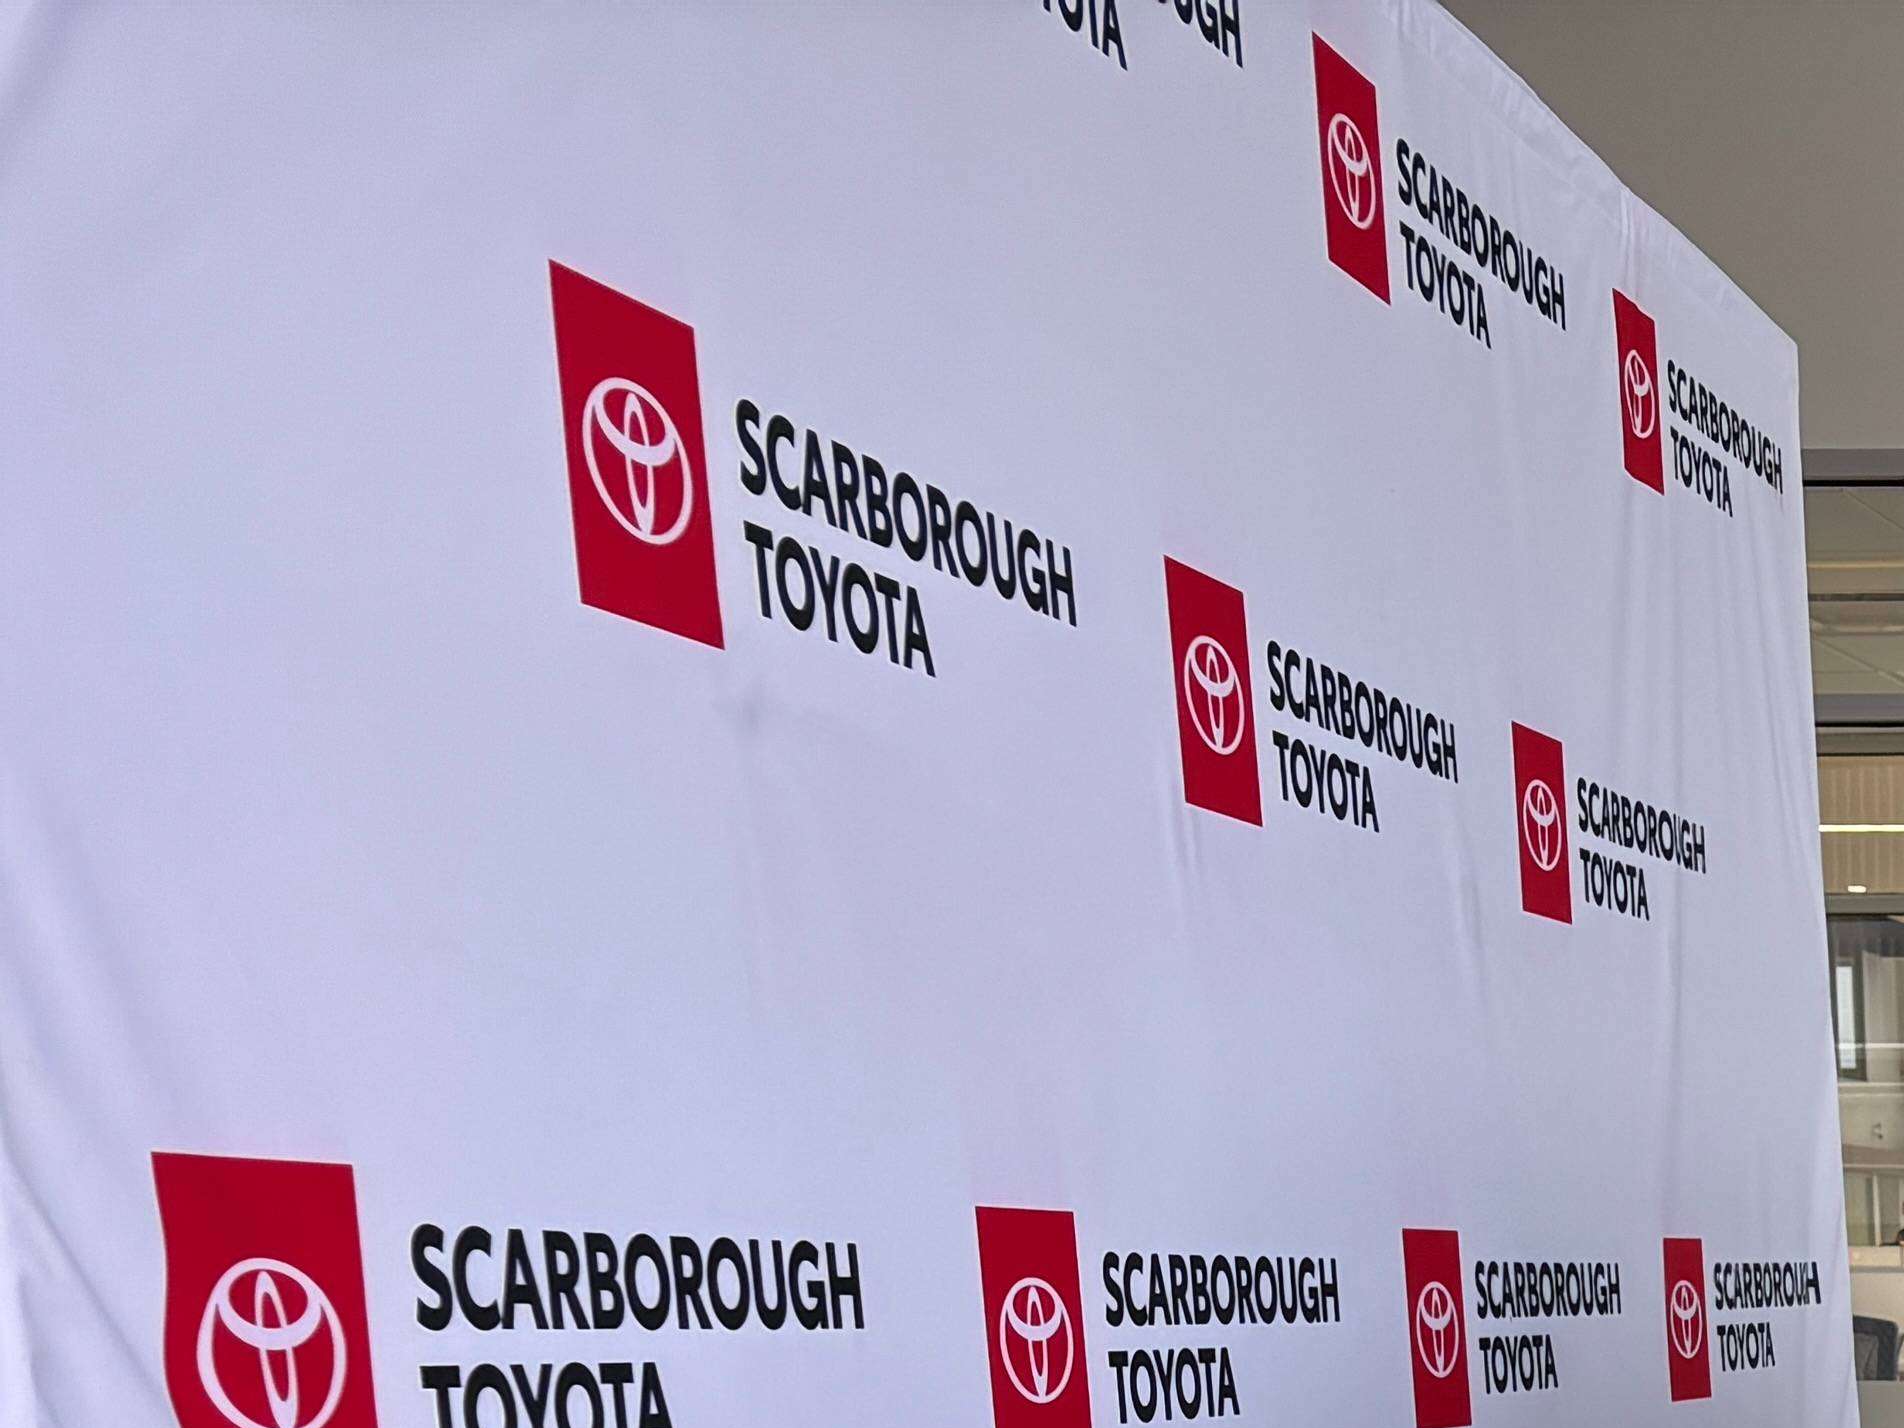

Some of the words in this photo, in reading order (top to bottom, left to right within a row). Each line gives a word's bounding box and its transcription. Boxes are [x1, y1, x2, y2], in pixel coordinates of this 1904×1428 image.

[1396, 138, 1567, 331] SCARBOROUGH
[1399, 220, 1492, 350] TOYOTA
[1667, 359, 1784, 495] SCARBOROUGH
[1669, 425, 1734, 518] TOYOTA
[736, 398, 1078, 628] SCARBOROUGH
[743, 520, 936, 678] TOYOTA
[1267, 640, 1459, 784] SCARBOROUGH
[1272, 729, 1380, 833] TOYOTA
[1576, 777, 1707, 875] SCARBOROUGH
[1579, 847, 1650, 922] TOYOTA
[411, 1223, 865, 1332] SCARBOROUGH
[1102, 1251, 1341, 1328] SCARBOROUGH
[1474, 1260, 1622, 1320] SCARBOROUGH
[1713, 1261, 1822, 1311] SCARBOROUH
[1107, 1346, 1241, 1425] TOYOTA
[1478, 1333, 1559, 1395] TOYOTA
[1716, 1321, 1776, 1372] TOYOTA
